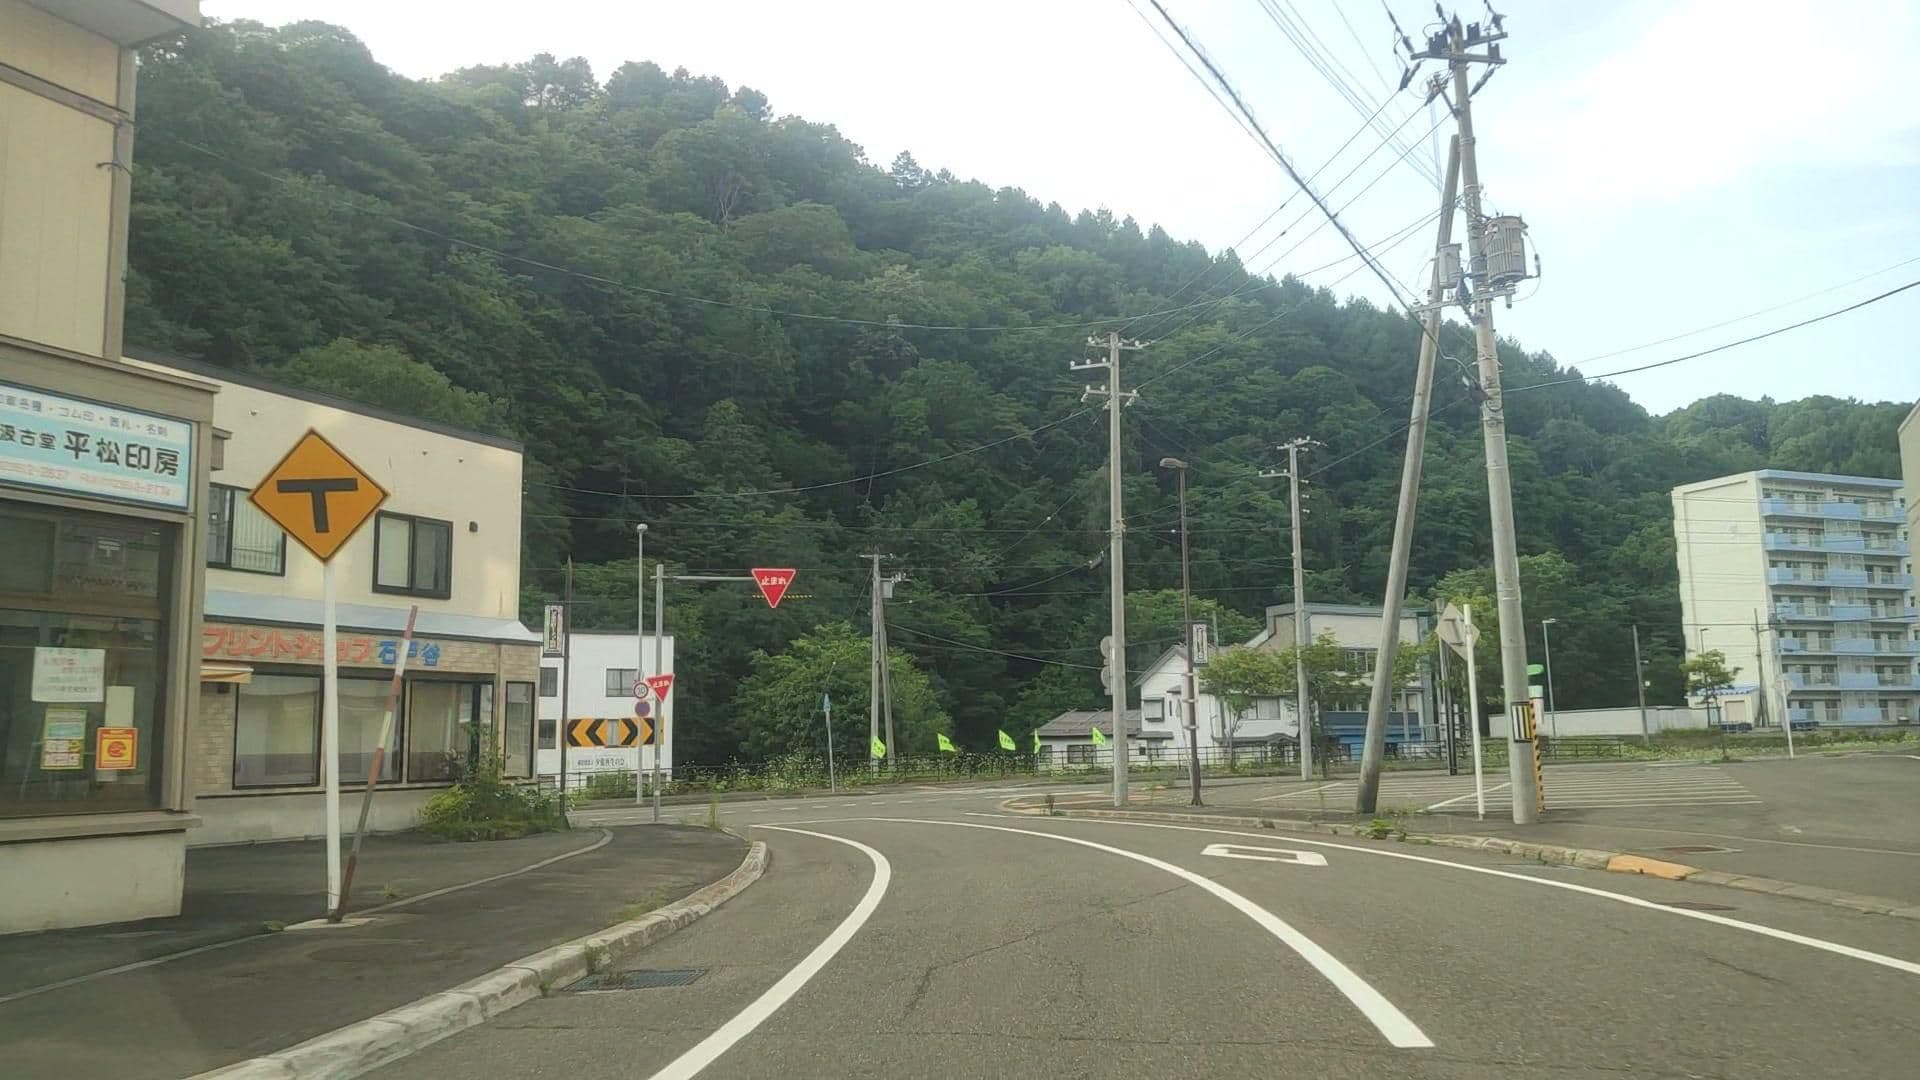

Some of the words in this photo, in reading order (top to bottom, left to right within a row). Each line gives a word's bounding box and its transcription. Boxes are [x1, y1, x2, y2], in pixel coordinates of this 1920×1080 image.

[64, 430, 180, 477] 平松印房
[761, 575, 788, 586] 止まれ
